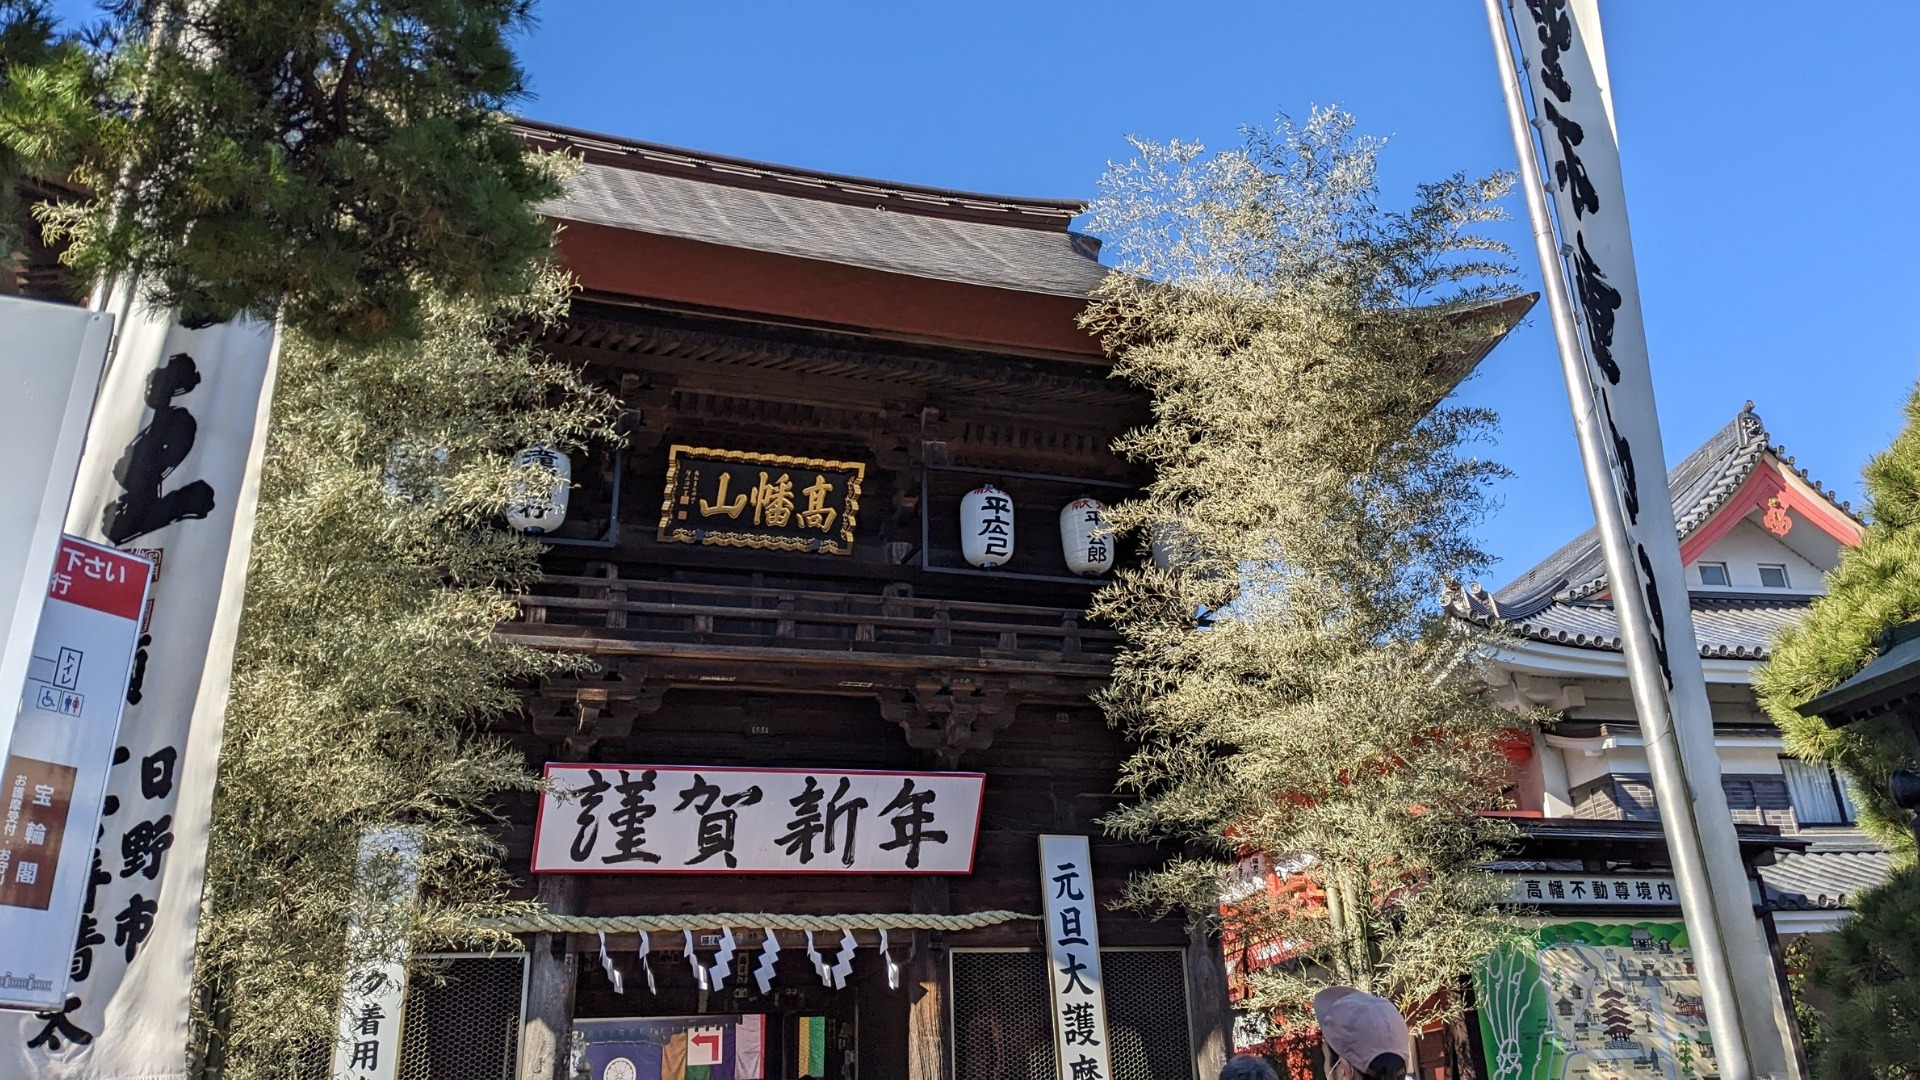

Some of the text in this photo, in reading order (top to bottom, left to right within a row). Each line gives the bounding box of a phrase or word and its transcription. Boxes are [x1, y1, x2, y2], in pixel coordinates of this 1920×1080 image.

[63, 547, 125, 583] 下さい
[62, 652, 76, 684] トイレ
[15, 784, 54, 885] 宝輪閣
[570, 769, 948, 869] 謹賀新年
[114, 746, 177, 964] 日野市
[1525, 879, 1673, 900] 高幡不動尊境内
